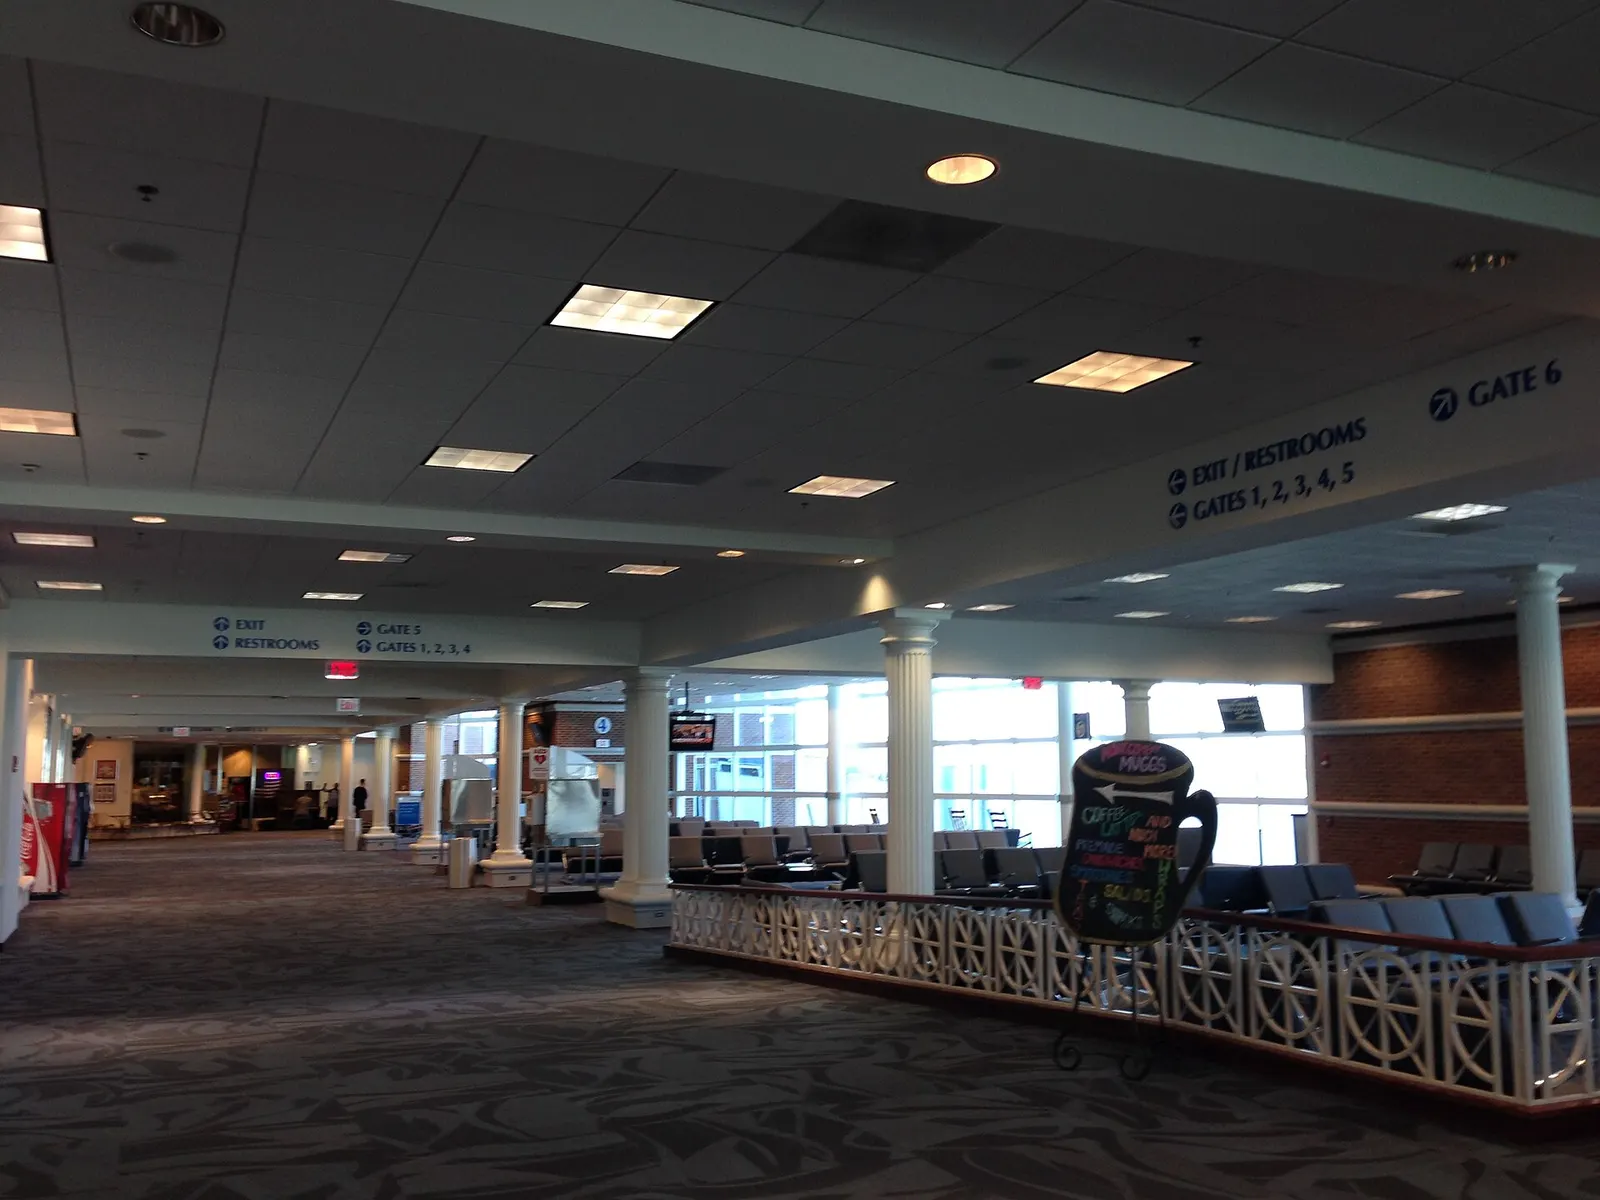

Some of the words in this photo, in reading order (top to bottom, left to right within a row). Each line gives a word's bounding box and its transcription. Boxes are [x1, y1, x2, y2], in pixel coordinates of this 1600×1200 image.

[1468, 365, 1537, 407] GATE
[1545, 358, 1562, 385] 6
[1193, 458, 1229, 487] EXIT
[1232, 453, 1240, 479] /
[1244, 416, 1368, 472] RESTROOMS
[1193, 489, 1247, 520] GATES
[1252, 486, 1268, 510] 1,
[1272, 480, 1288, 504] 2,
[1295, 474, 1312, 498] 3,
[1318, 467, 1336, 492] 4,
[1341, 461, 1355, 484] 5
[235, 619, 265, 631] EXIT
[376, 623, 411, 635] GATE
[413, 625, 421, 635] 5
[235, 637, 320, 651] RESTROOMS
[376, 641, 416, 653] GATES
[420, 643, 430, 654] 1,
[434, 643, 445, 655] 2,
[448, 643, 460, 656] 3,
[463, 644, 471, 654] 4
[597, 718, 607, 732] 4
[1119, 755, 1168, 773] MUGGS
